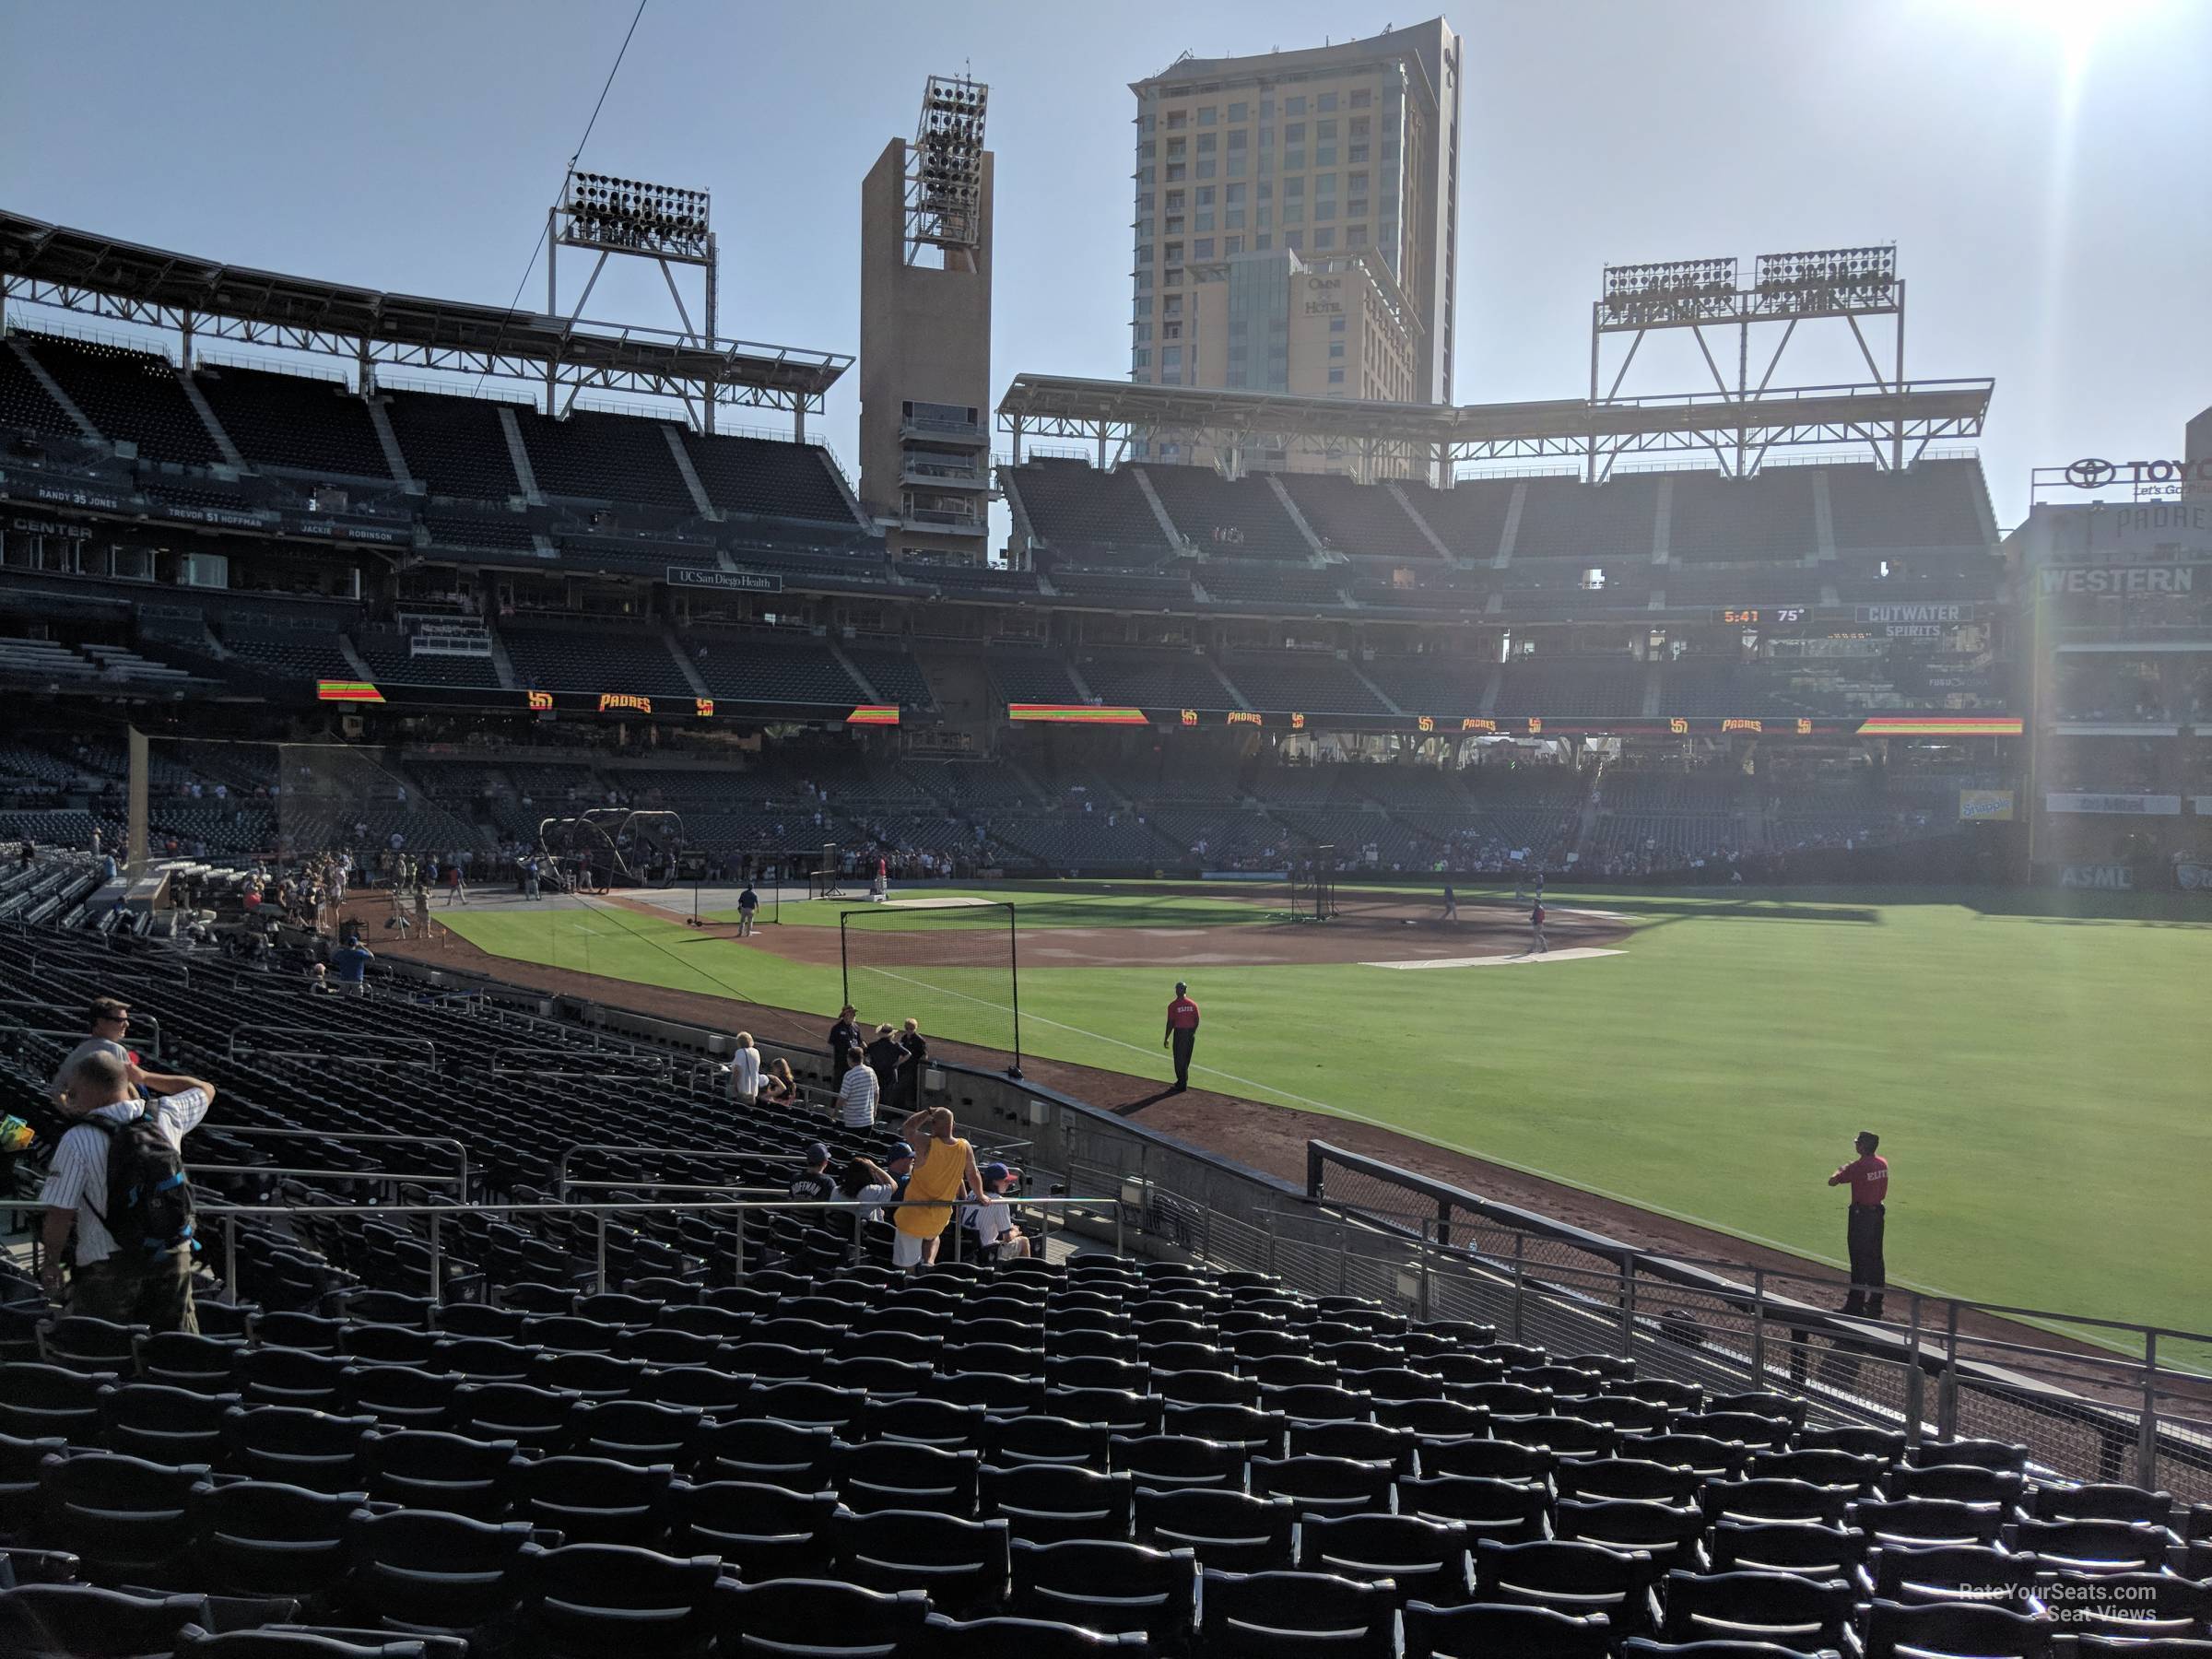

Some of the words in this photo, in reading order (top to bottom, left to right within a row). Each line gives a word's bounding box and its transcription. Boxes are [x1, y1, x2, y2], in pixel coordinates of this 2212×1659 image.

[1305, 301, 1343, 314] HOTEL
[39, 488, 71, 501] RANDY
[74, 494, 87, 505] 35
[89, 498, 118, 509] JONES
[169, 508, 204, 520] TREVOR
[206, 512, 218, 523] 51
[220, 516, 263, 527] HOFFMAN
[14, 519, 93, 539] CENTER
[301, 524, 332, 535] JACKIE
[348, 529, 393, 541] ROBINSON
[680, 571, 696, 582] UC
[696, 571, 714, 583] San
[715, 574, 741, 587] Diego
[742, 576, 771, 587] Health
[2042, 568, 2193, 592] WESTERN
[1724, 610, 1759, 623] 5:41
[1869, 606, 1959, 621] CUTWATER
[1886, 626, 1940, 637] SPIRITS
[599, 693, 652, 713] PADRES
[1227, 712, 1263, 725] PADRES
[1462, 718, 1496, 732] PADRES
[1722, 719, 1762, 733] PADRES
